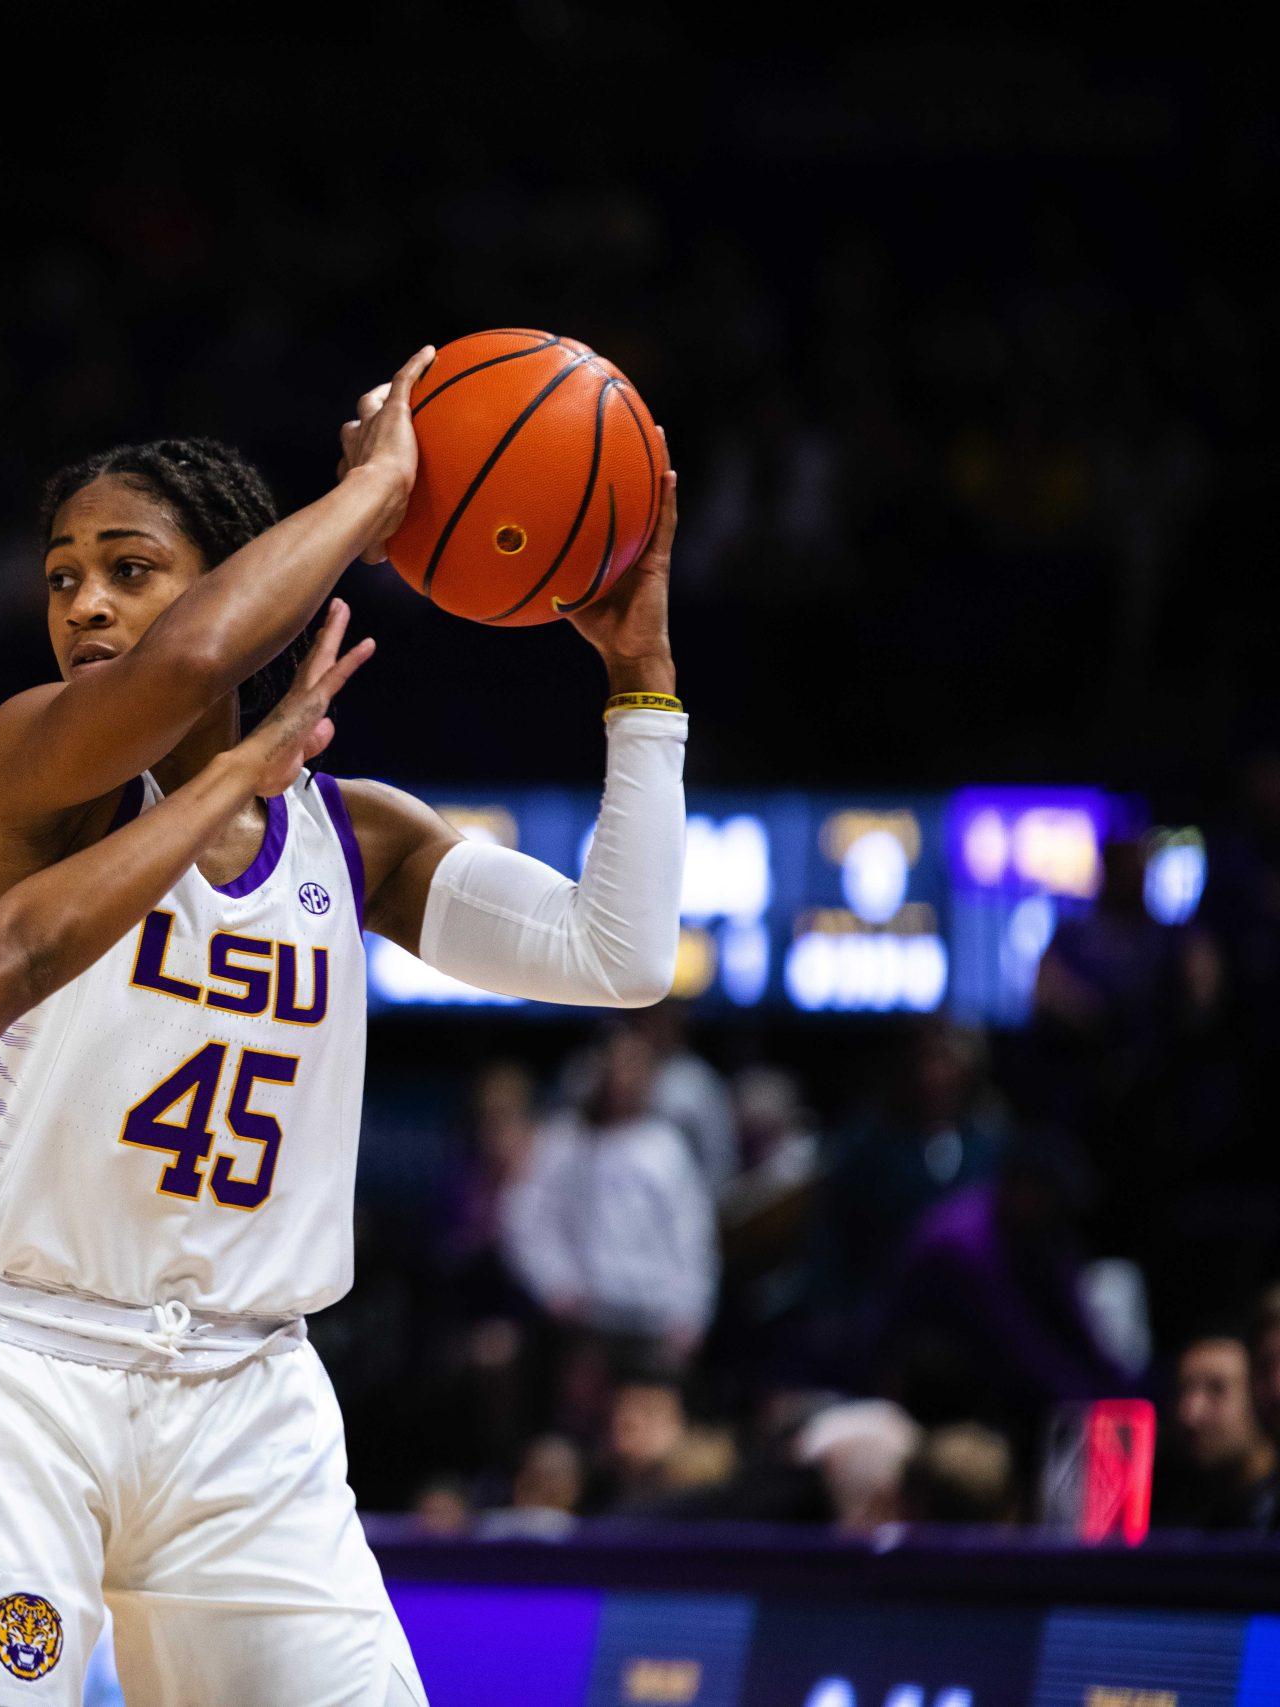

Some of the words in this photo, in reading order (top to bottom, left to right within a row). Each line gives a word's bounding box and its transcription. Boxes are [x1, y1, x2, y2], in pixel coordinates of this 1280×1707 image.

[299, 882, 330, 914] SEC
[128, 908, 329, 1027] LSU
[118, 1039, 301, 1213] 45
